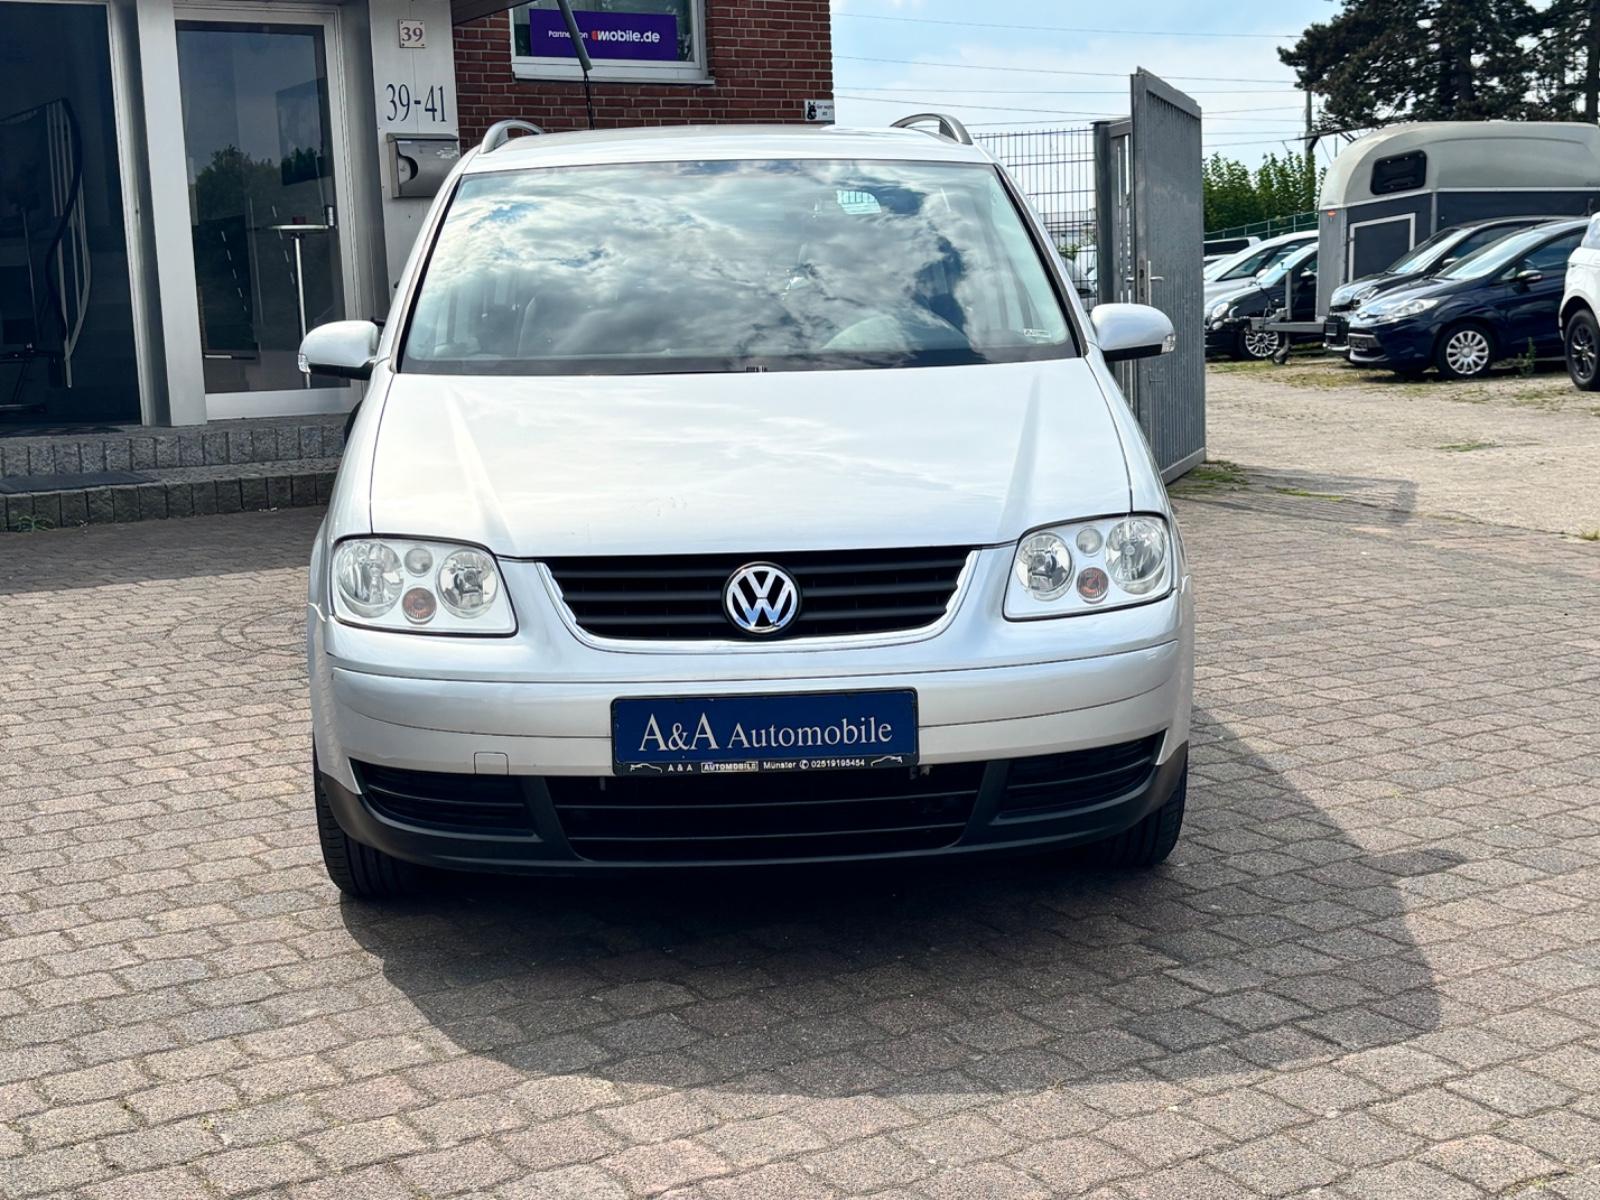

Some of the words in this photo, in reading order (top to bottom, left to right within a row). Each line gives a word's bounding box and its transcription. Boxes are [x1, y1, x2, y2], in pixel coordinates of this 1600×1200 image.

[401, 27, 423, 43] 39
[548, 30, 571, 38] Partne
[597, 30, 660, 42] mobile.de
[386, 83, 447, 122] 39-41
[638, 712, 719, 751] A&A
[727, 717, 893, 749] Automobile
[763, 761, 796, 769] Münster
